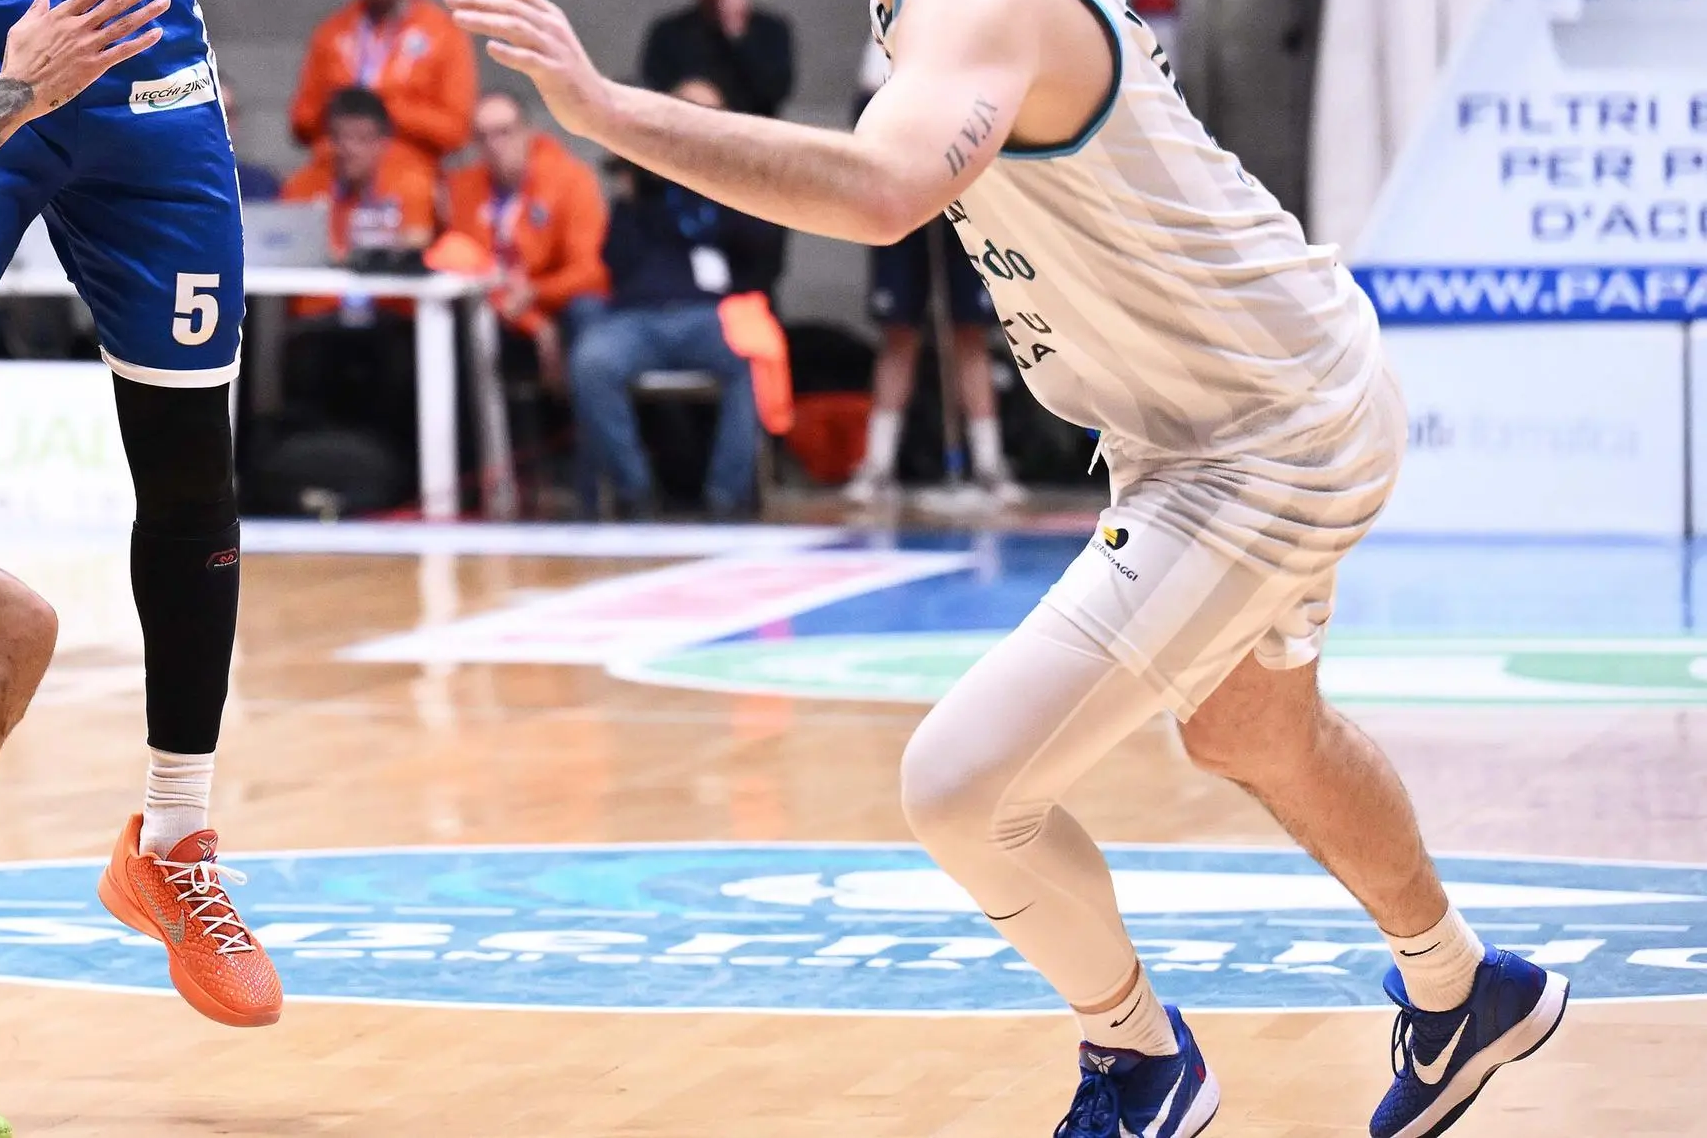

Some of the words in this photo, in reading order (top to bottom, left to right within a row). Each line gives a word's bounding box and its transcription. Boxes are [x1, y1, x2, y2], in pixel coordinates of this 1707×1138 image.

[134, 86, 181, 102] VECCHI
[1532, 200, 1707, 243] D'AC
[171, 272, 221, 346] 5
